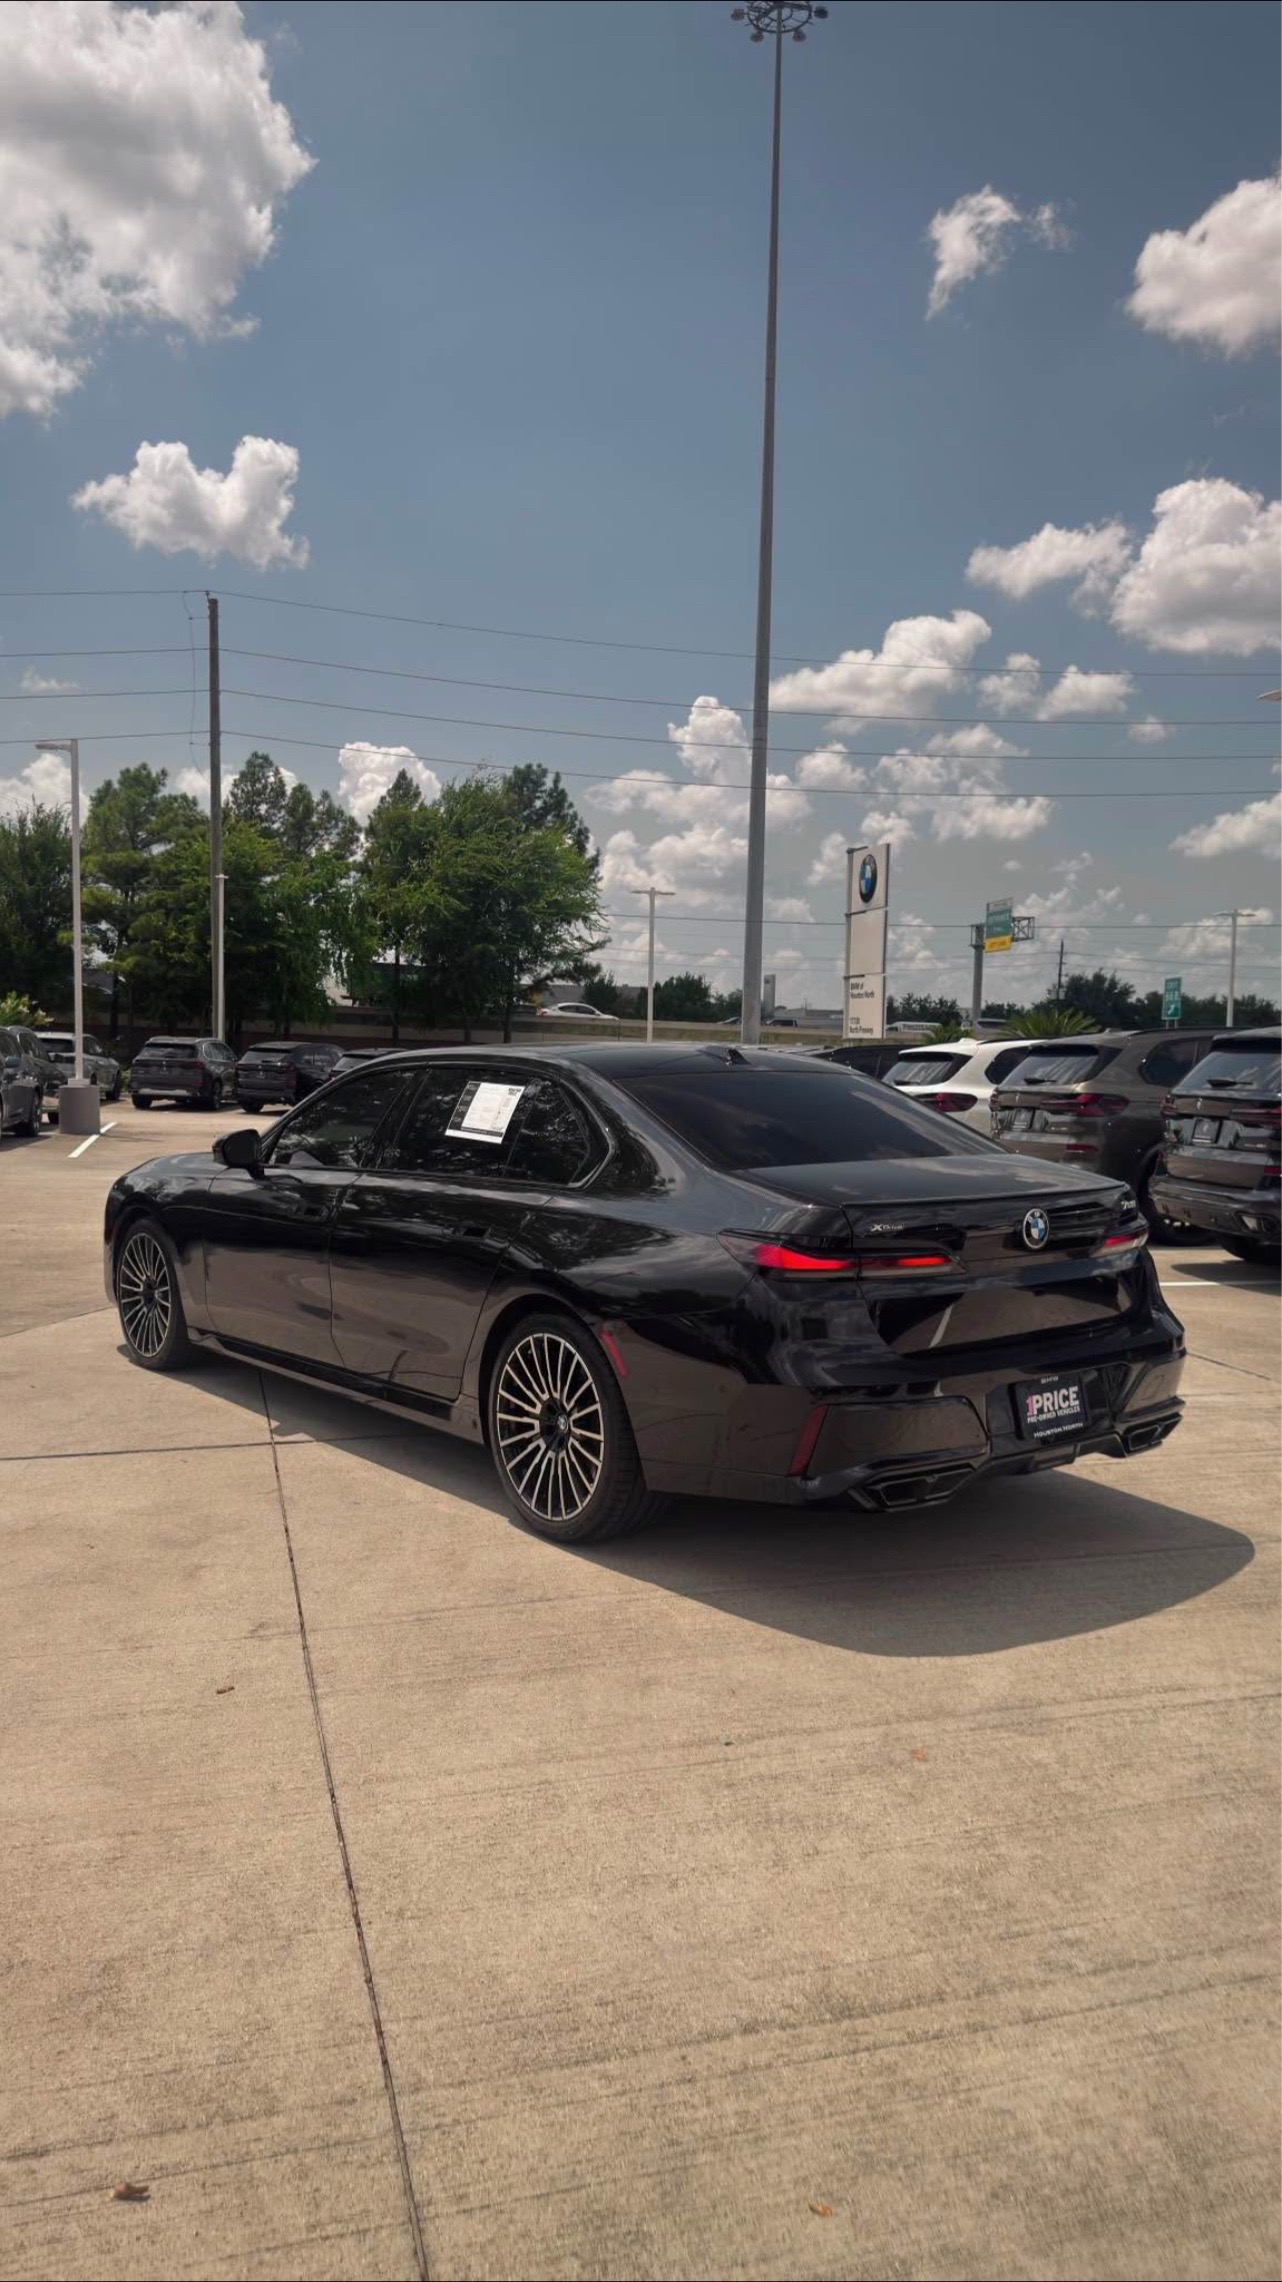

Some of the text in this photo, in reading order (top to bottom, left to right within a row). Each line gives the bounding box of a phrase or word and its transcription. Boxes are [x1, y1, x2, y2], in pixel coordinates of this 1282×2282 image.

[1041, 1376, 1059, 1384] BMW
[1057, 1405, 1081, 1417] VEHICLES
[1034, 1422, 1084, 1438] HOUSTON NORTH
